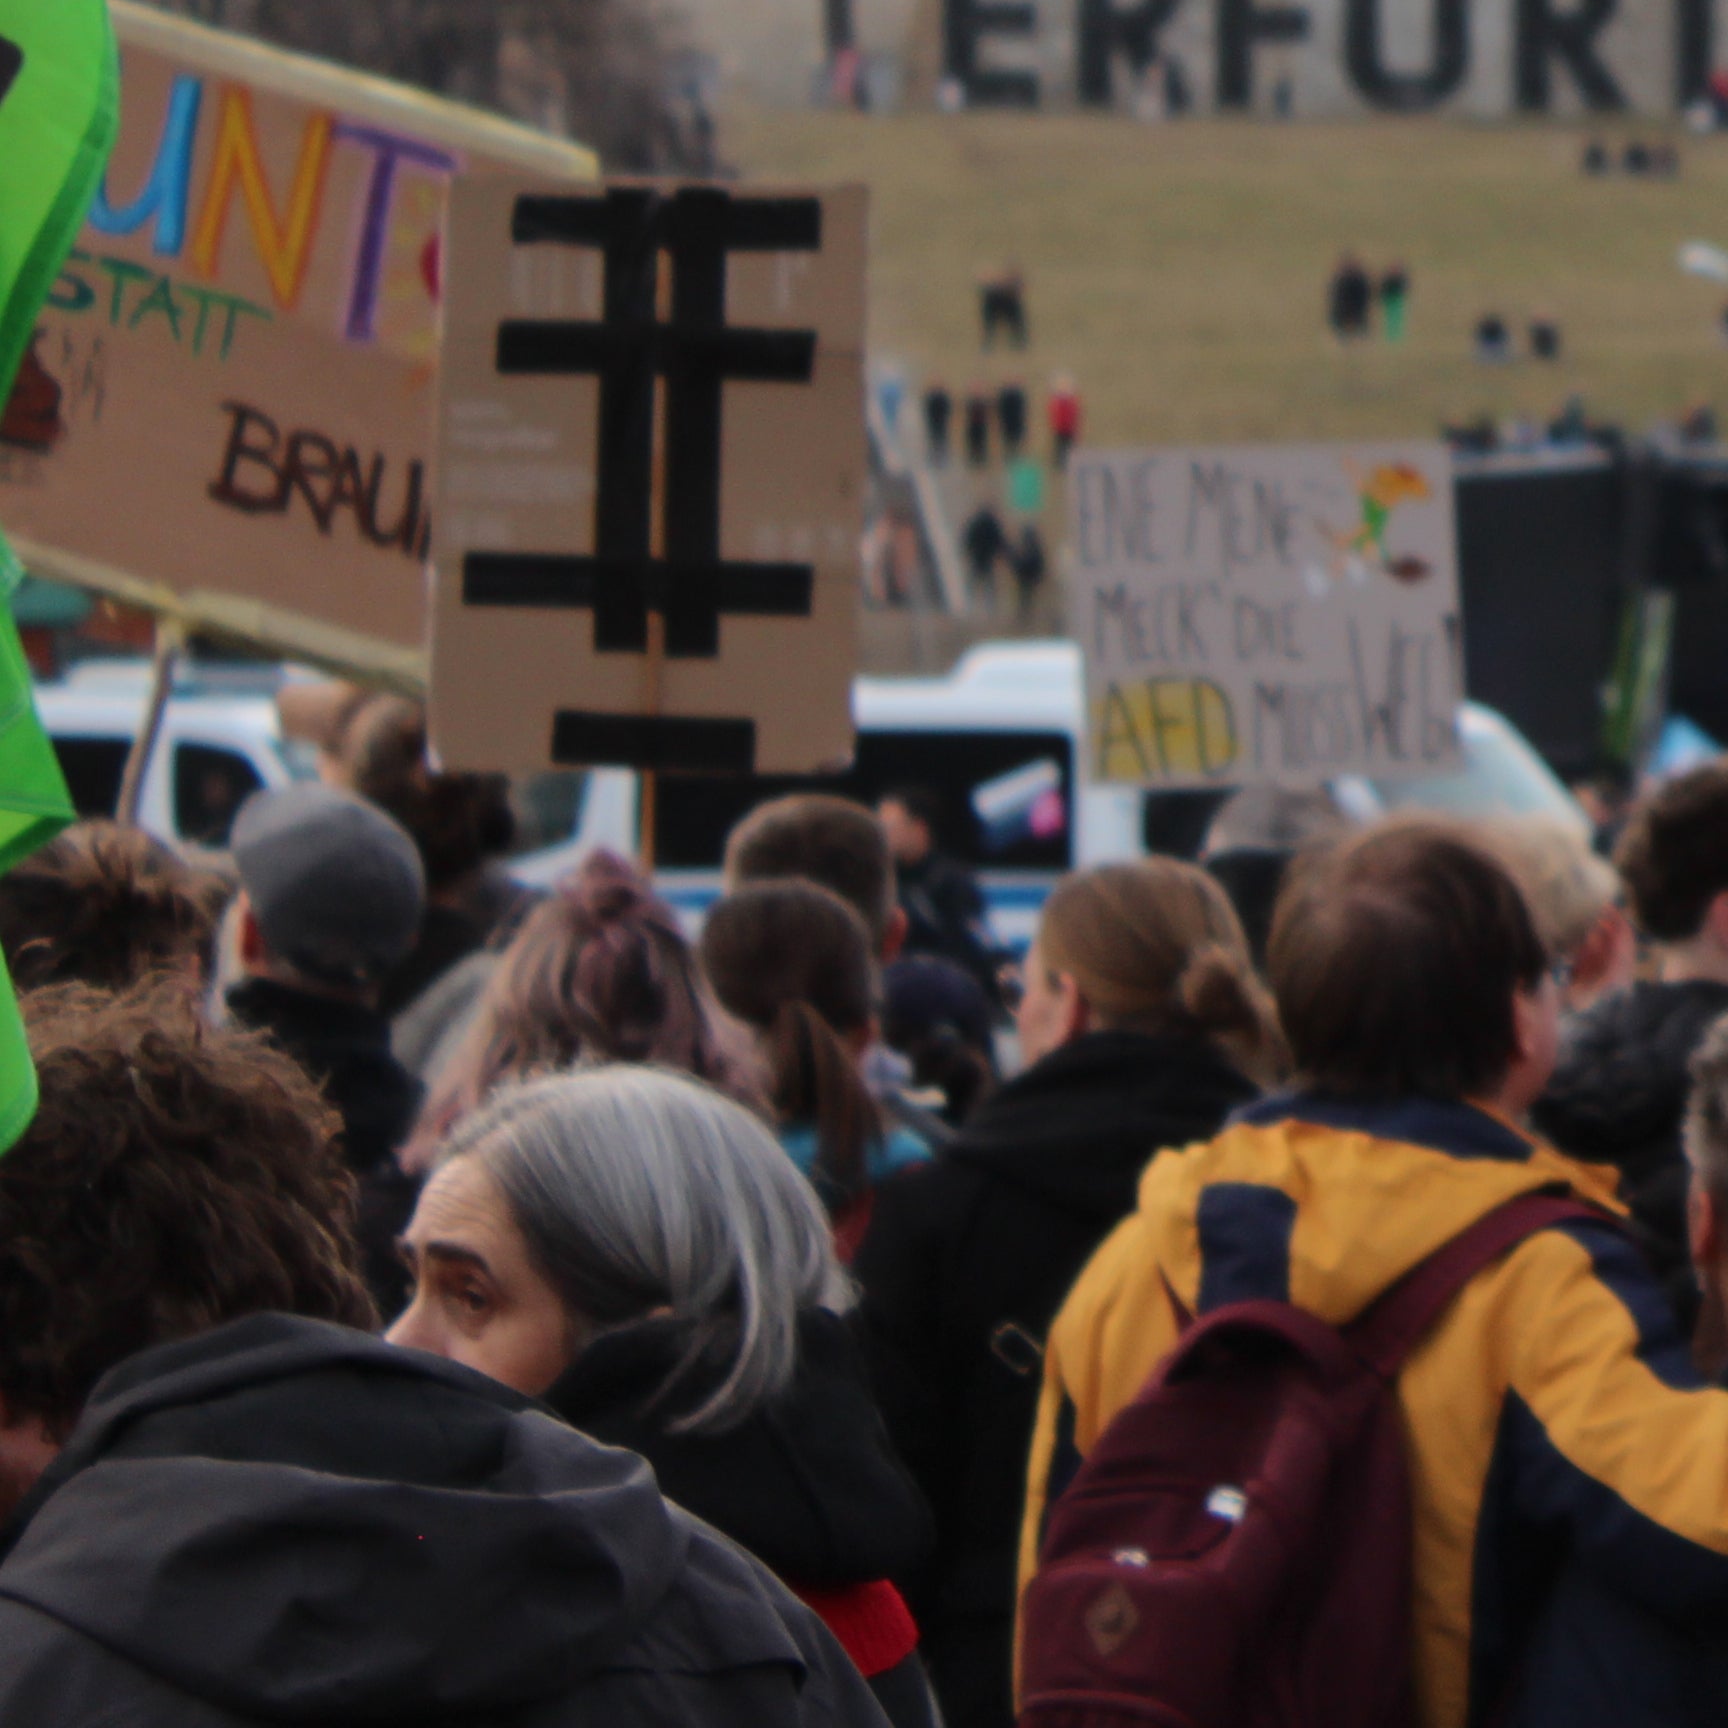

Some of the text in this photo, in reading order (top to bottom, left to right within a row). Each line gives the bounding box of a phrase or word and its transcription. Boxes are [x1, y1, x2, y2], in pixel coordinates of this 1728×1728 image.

[84, 74, 462, 344] UNT
[208, 397, 431, 562] BRAU
[1099, 677, 1237, 778] AFD
